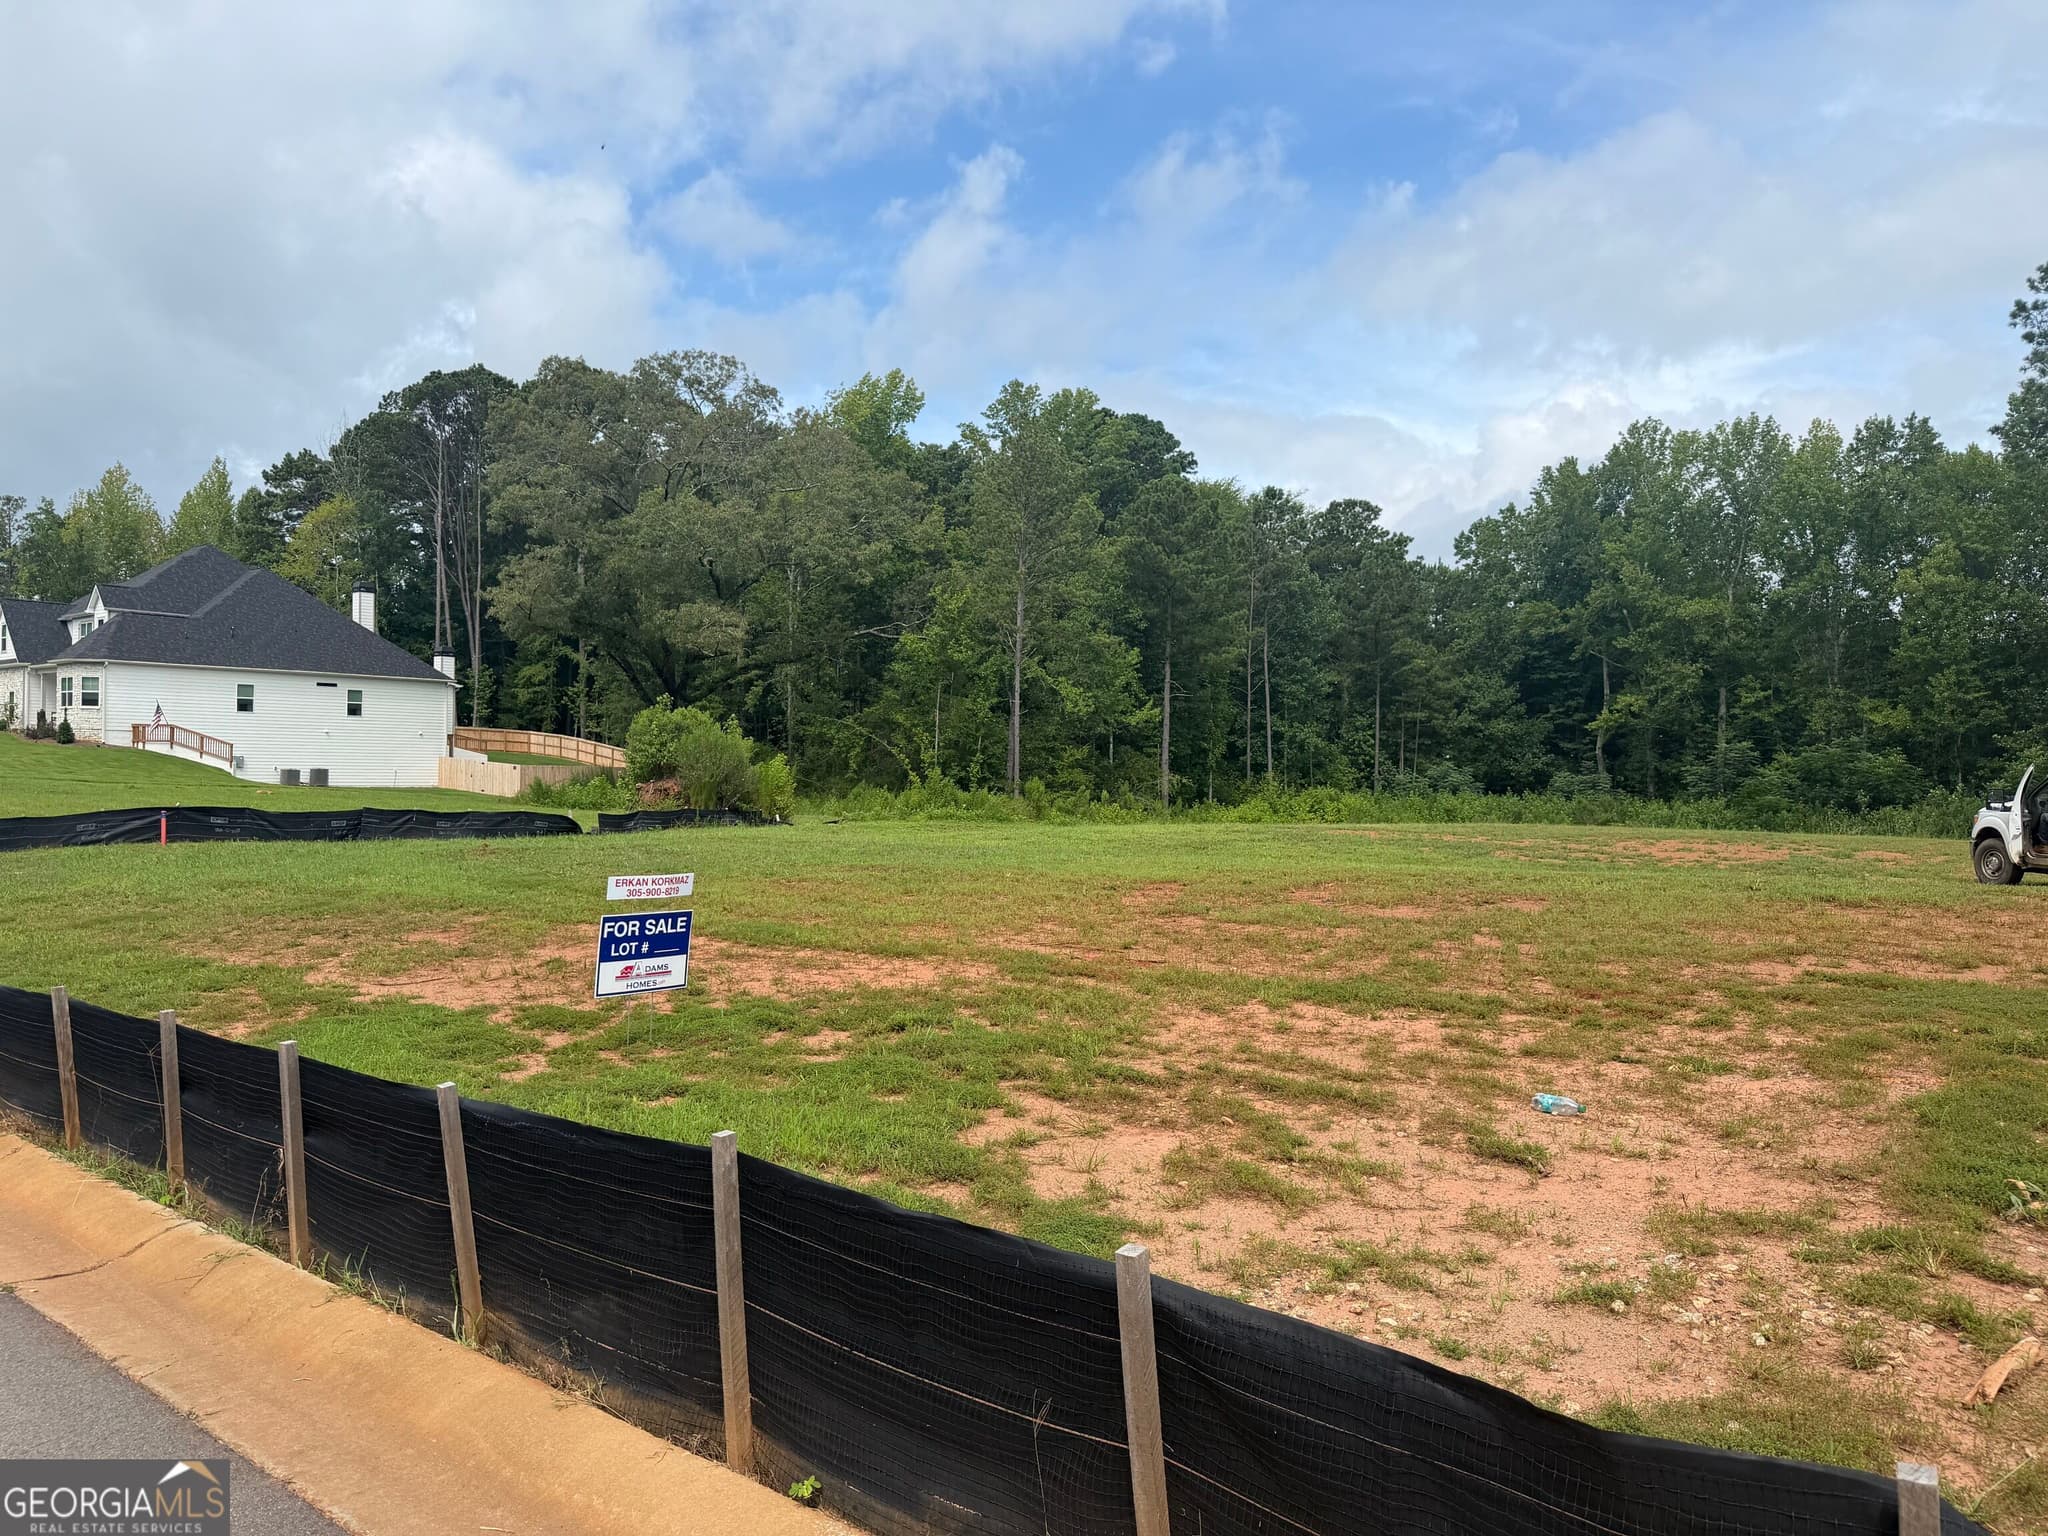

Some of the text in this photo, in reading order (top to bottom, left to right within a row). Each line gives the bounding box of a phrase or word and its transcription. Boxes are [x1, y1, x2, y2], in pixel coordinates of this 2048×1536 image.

[615, 875, 690, 888] ERKAN KORKMAZ
[626, 886, 680, 898] 305-900-8219
[603, 917, 687, 938] FOR SALE
[610, 941, 649, 957] LOT #
[626, 979, 658, 990] HOMES
